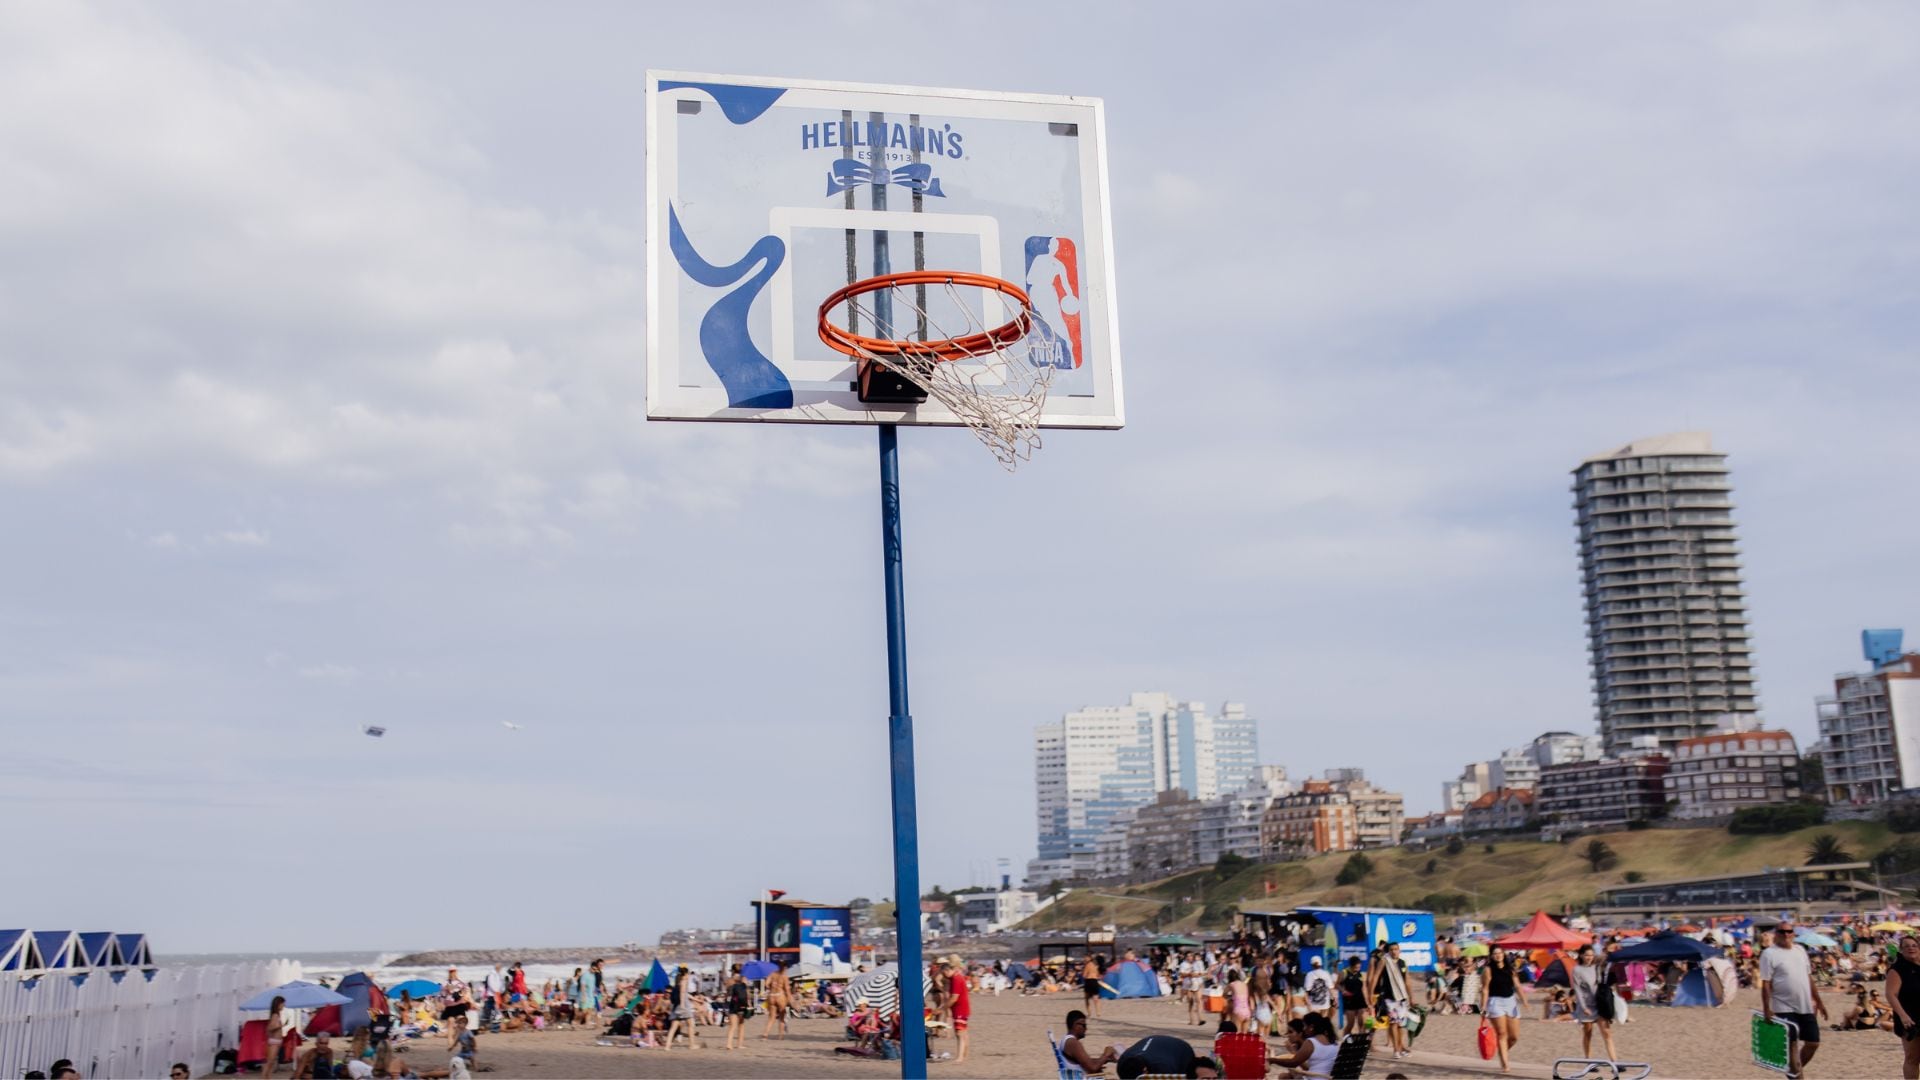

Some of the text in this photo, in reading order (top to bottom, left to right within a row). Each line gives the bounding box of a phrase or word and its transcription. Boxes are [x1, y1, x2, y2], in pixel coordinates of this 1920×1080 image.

[802, 121, 963, 160] HELLMANN'S
[886, 152, 912, 162] 1913
[1035, 341, 1064, 364] NBA
